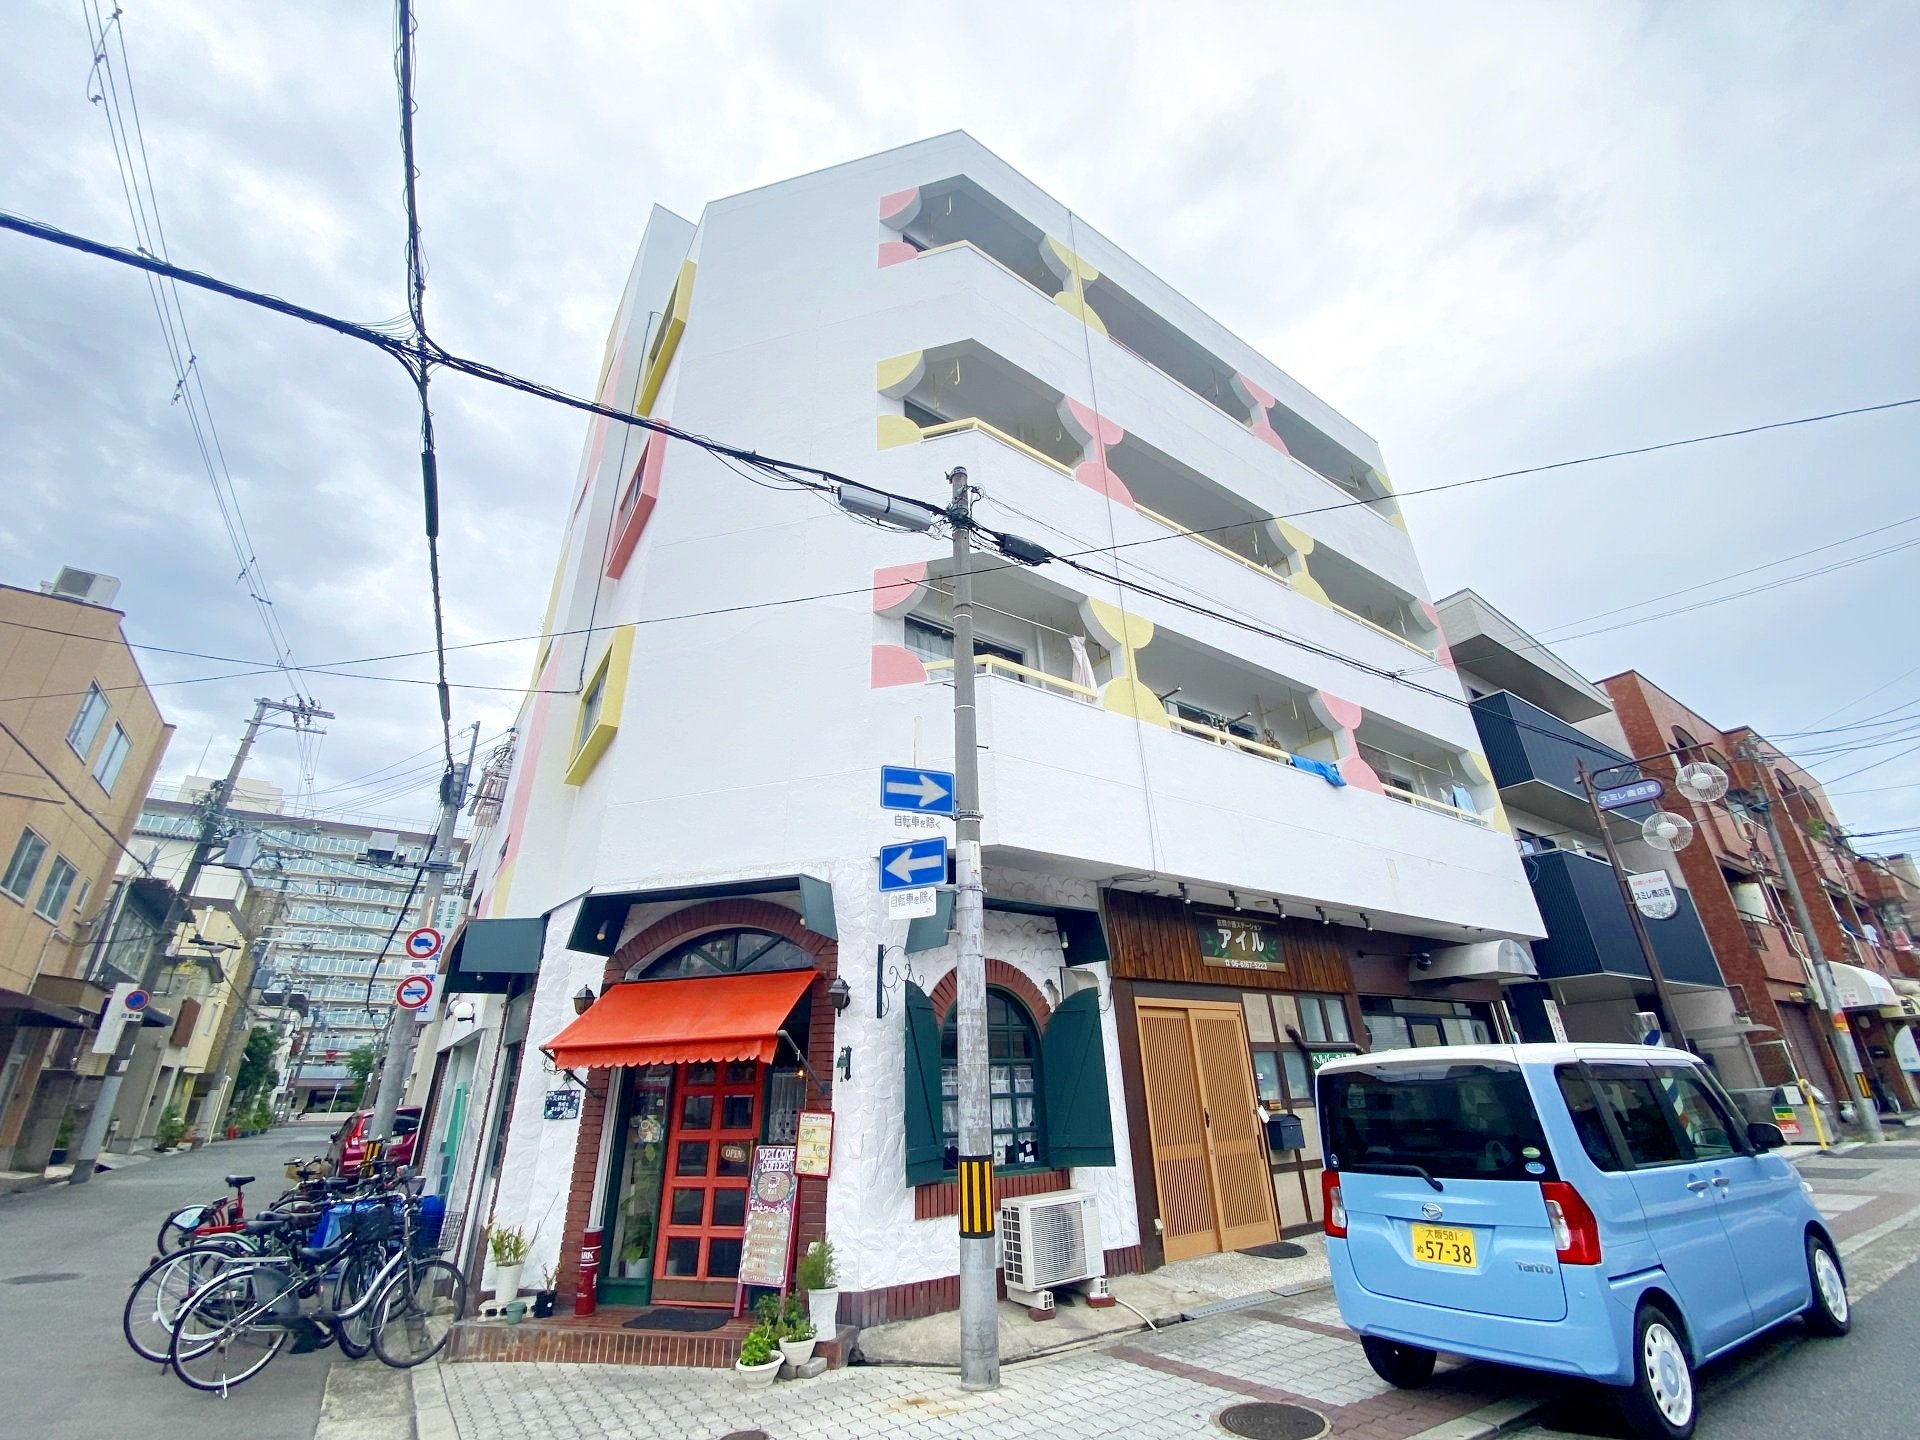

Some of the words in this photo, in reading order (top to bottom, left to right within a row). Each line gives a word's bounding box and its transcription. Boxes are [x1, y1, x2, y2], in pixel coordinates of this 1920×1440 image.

[1600, 784, 1656, 804] スミレ商店街
[894, 814, 942, 829] 自転車を除く
[890, 891, 934, 908] 自転車を除く
[1634, 888, 1671, 901] スミレ商店街
[1217, 929, 1265, 952] アイル
[725, 1149, 743, 1160] OPEN
[758, 1148, 796, 1161] WELCOME
[761, 1160, 790, 1172] COFFEE
[1425, 1241, 1472, 1264] 57-38
[1515, 1261, 1554, 1275] Tanto
